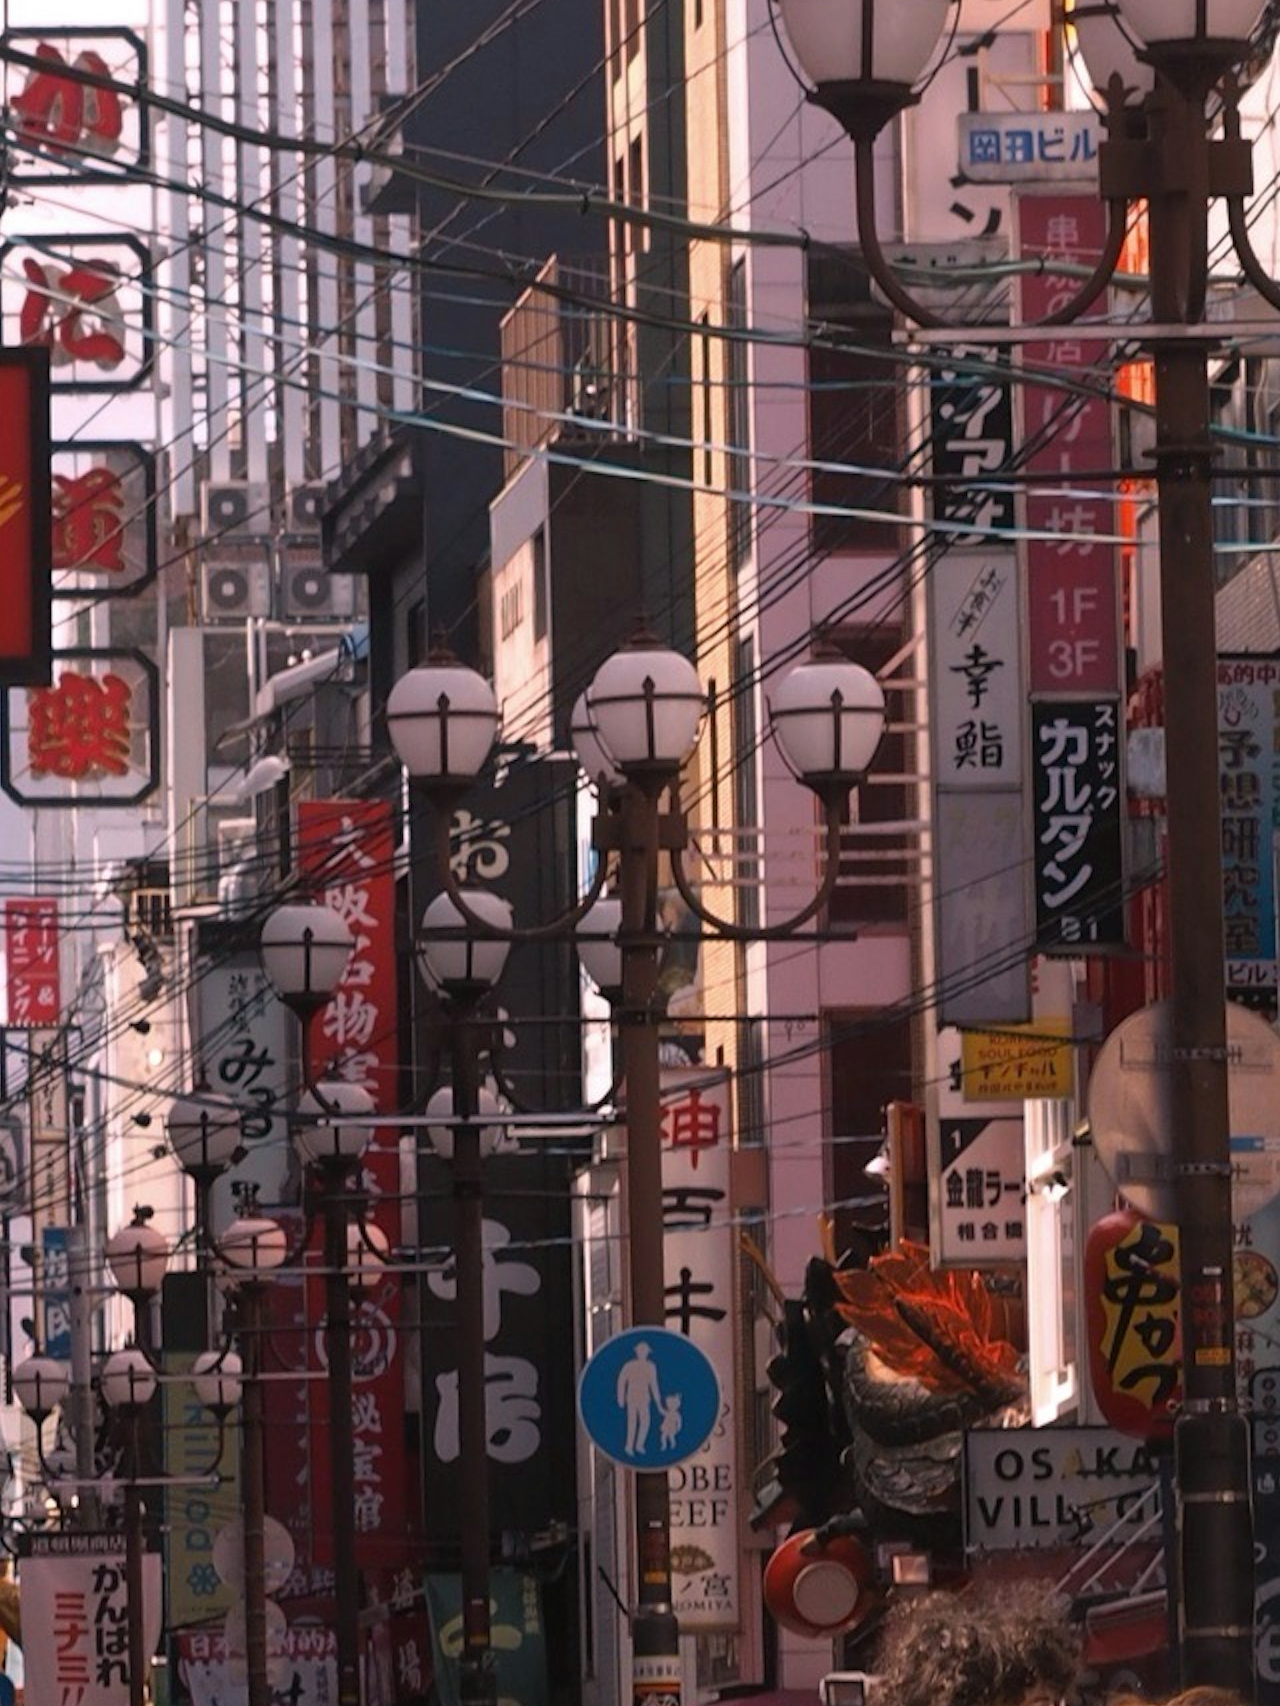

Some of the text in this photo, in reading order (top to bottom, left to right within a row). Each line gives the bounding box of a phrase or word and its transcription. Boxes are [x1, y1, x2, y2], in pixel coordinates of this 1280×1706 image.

[1051, 589, 1098, 623] 1F
[1050, 641, 1098, 678] 3F
[950, 644, 1005, 770] 幸鮨
[1095, 704, 1115, 809] スナック
[1040, 719, 1094, 907] カルダン
[1062, 916, 1098, 941] B1
[1228, 963, 1277, 984] ビル
[946, 1167, 1026, 1209] 金龍ラー
[92, 1563, 131, 1690] がんばれ
